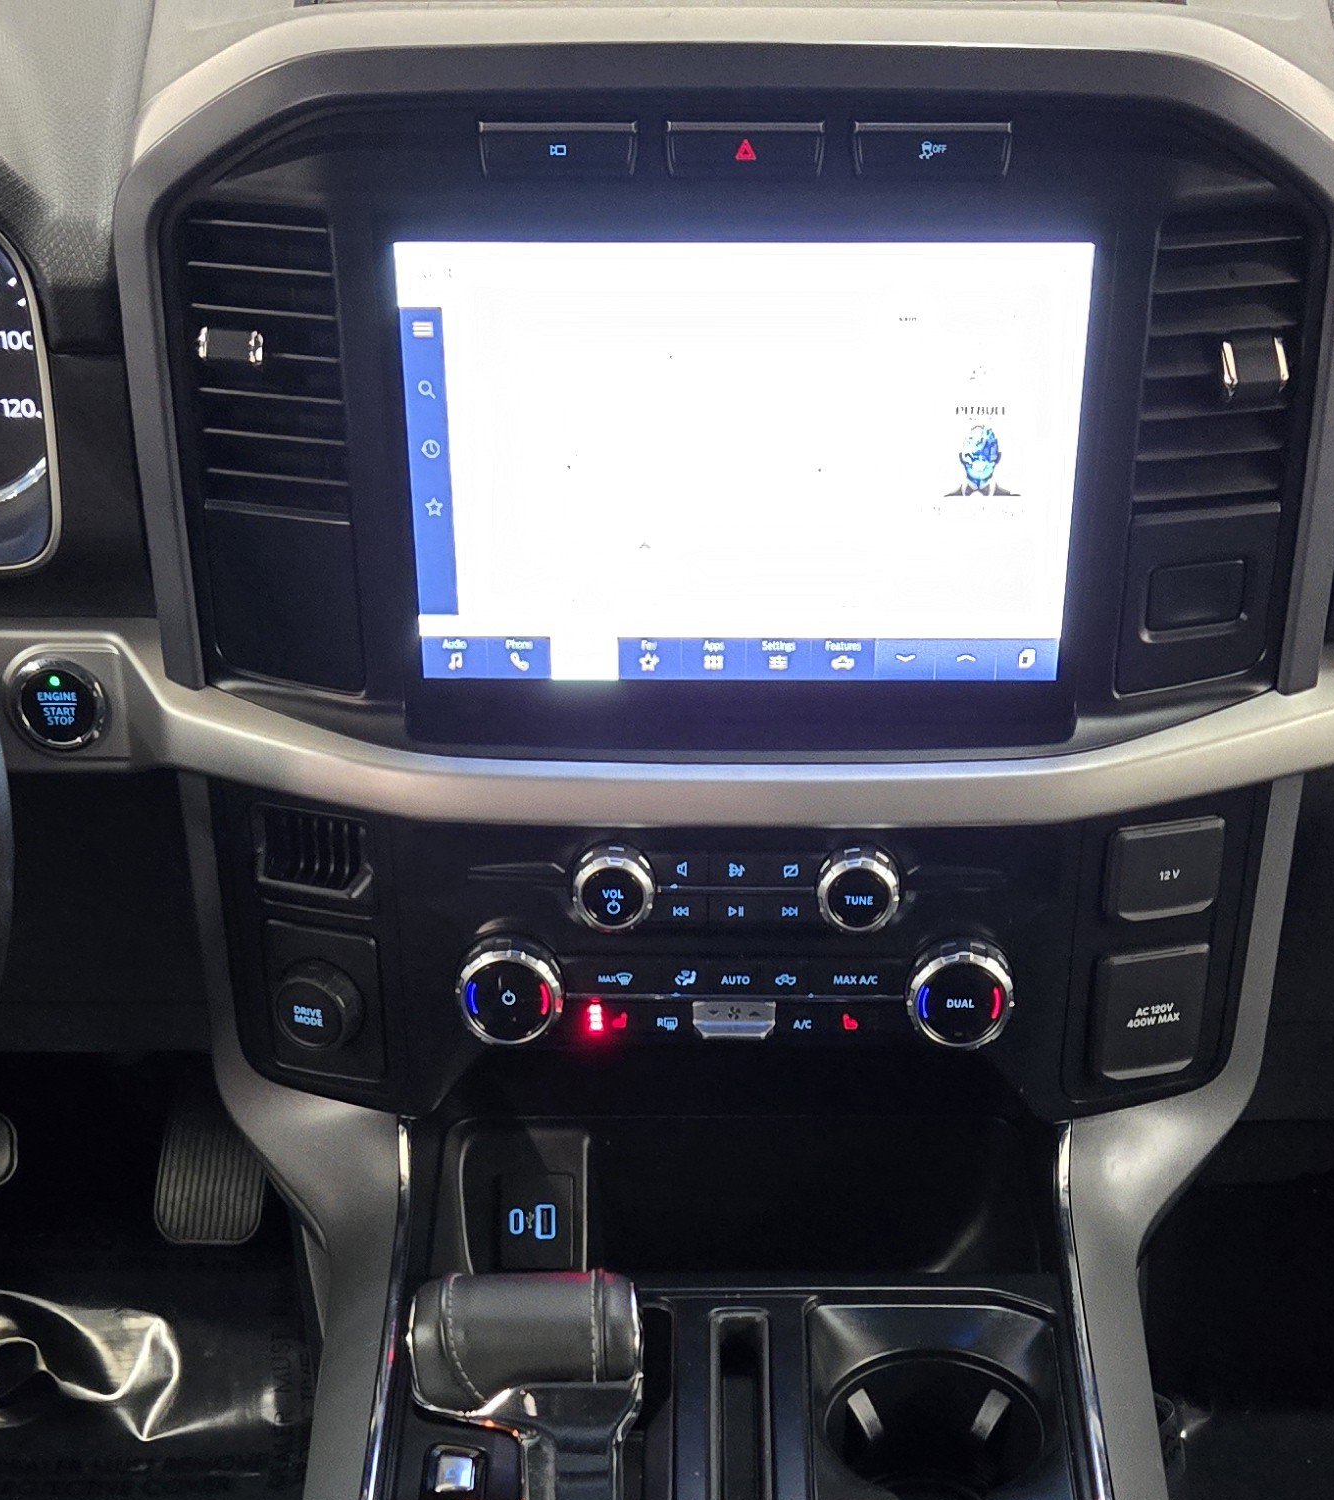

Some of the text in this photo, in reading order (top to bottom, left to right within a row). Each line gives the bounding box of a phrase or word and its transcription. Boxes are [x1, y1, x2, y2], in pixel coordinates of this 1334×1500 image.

[0, 397, 37, 419] 120
[36, 691, 78, 702] ENGINE
[43, 707, 76, 717] START
[47, 716, 75, 726] STOP
[601, 888, 625, 900] VOL
[844, 895, 875, 906] TUNE
[597, 974, 617, 984] MAX
[720, 974, 751, 986] AUTO
[833, 974, 879, 986] MAX A/C
[946, 998, 975, 1009] DUAL
[293, 1005, 323, 1018] DRIVE
[1134, 1002, 1174, 1018] AC 120V
[293, 1014, 324, 1028] MODE
[793, 1018, 812, 1030] A/C
[1126, 1011, 1181, 1029] 400W MAX
